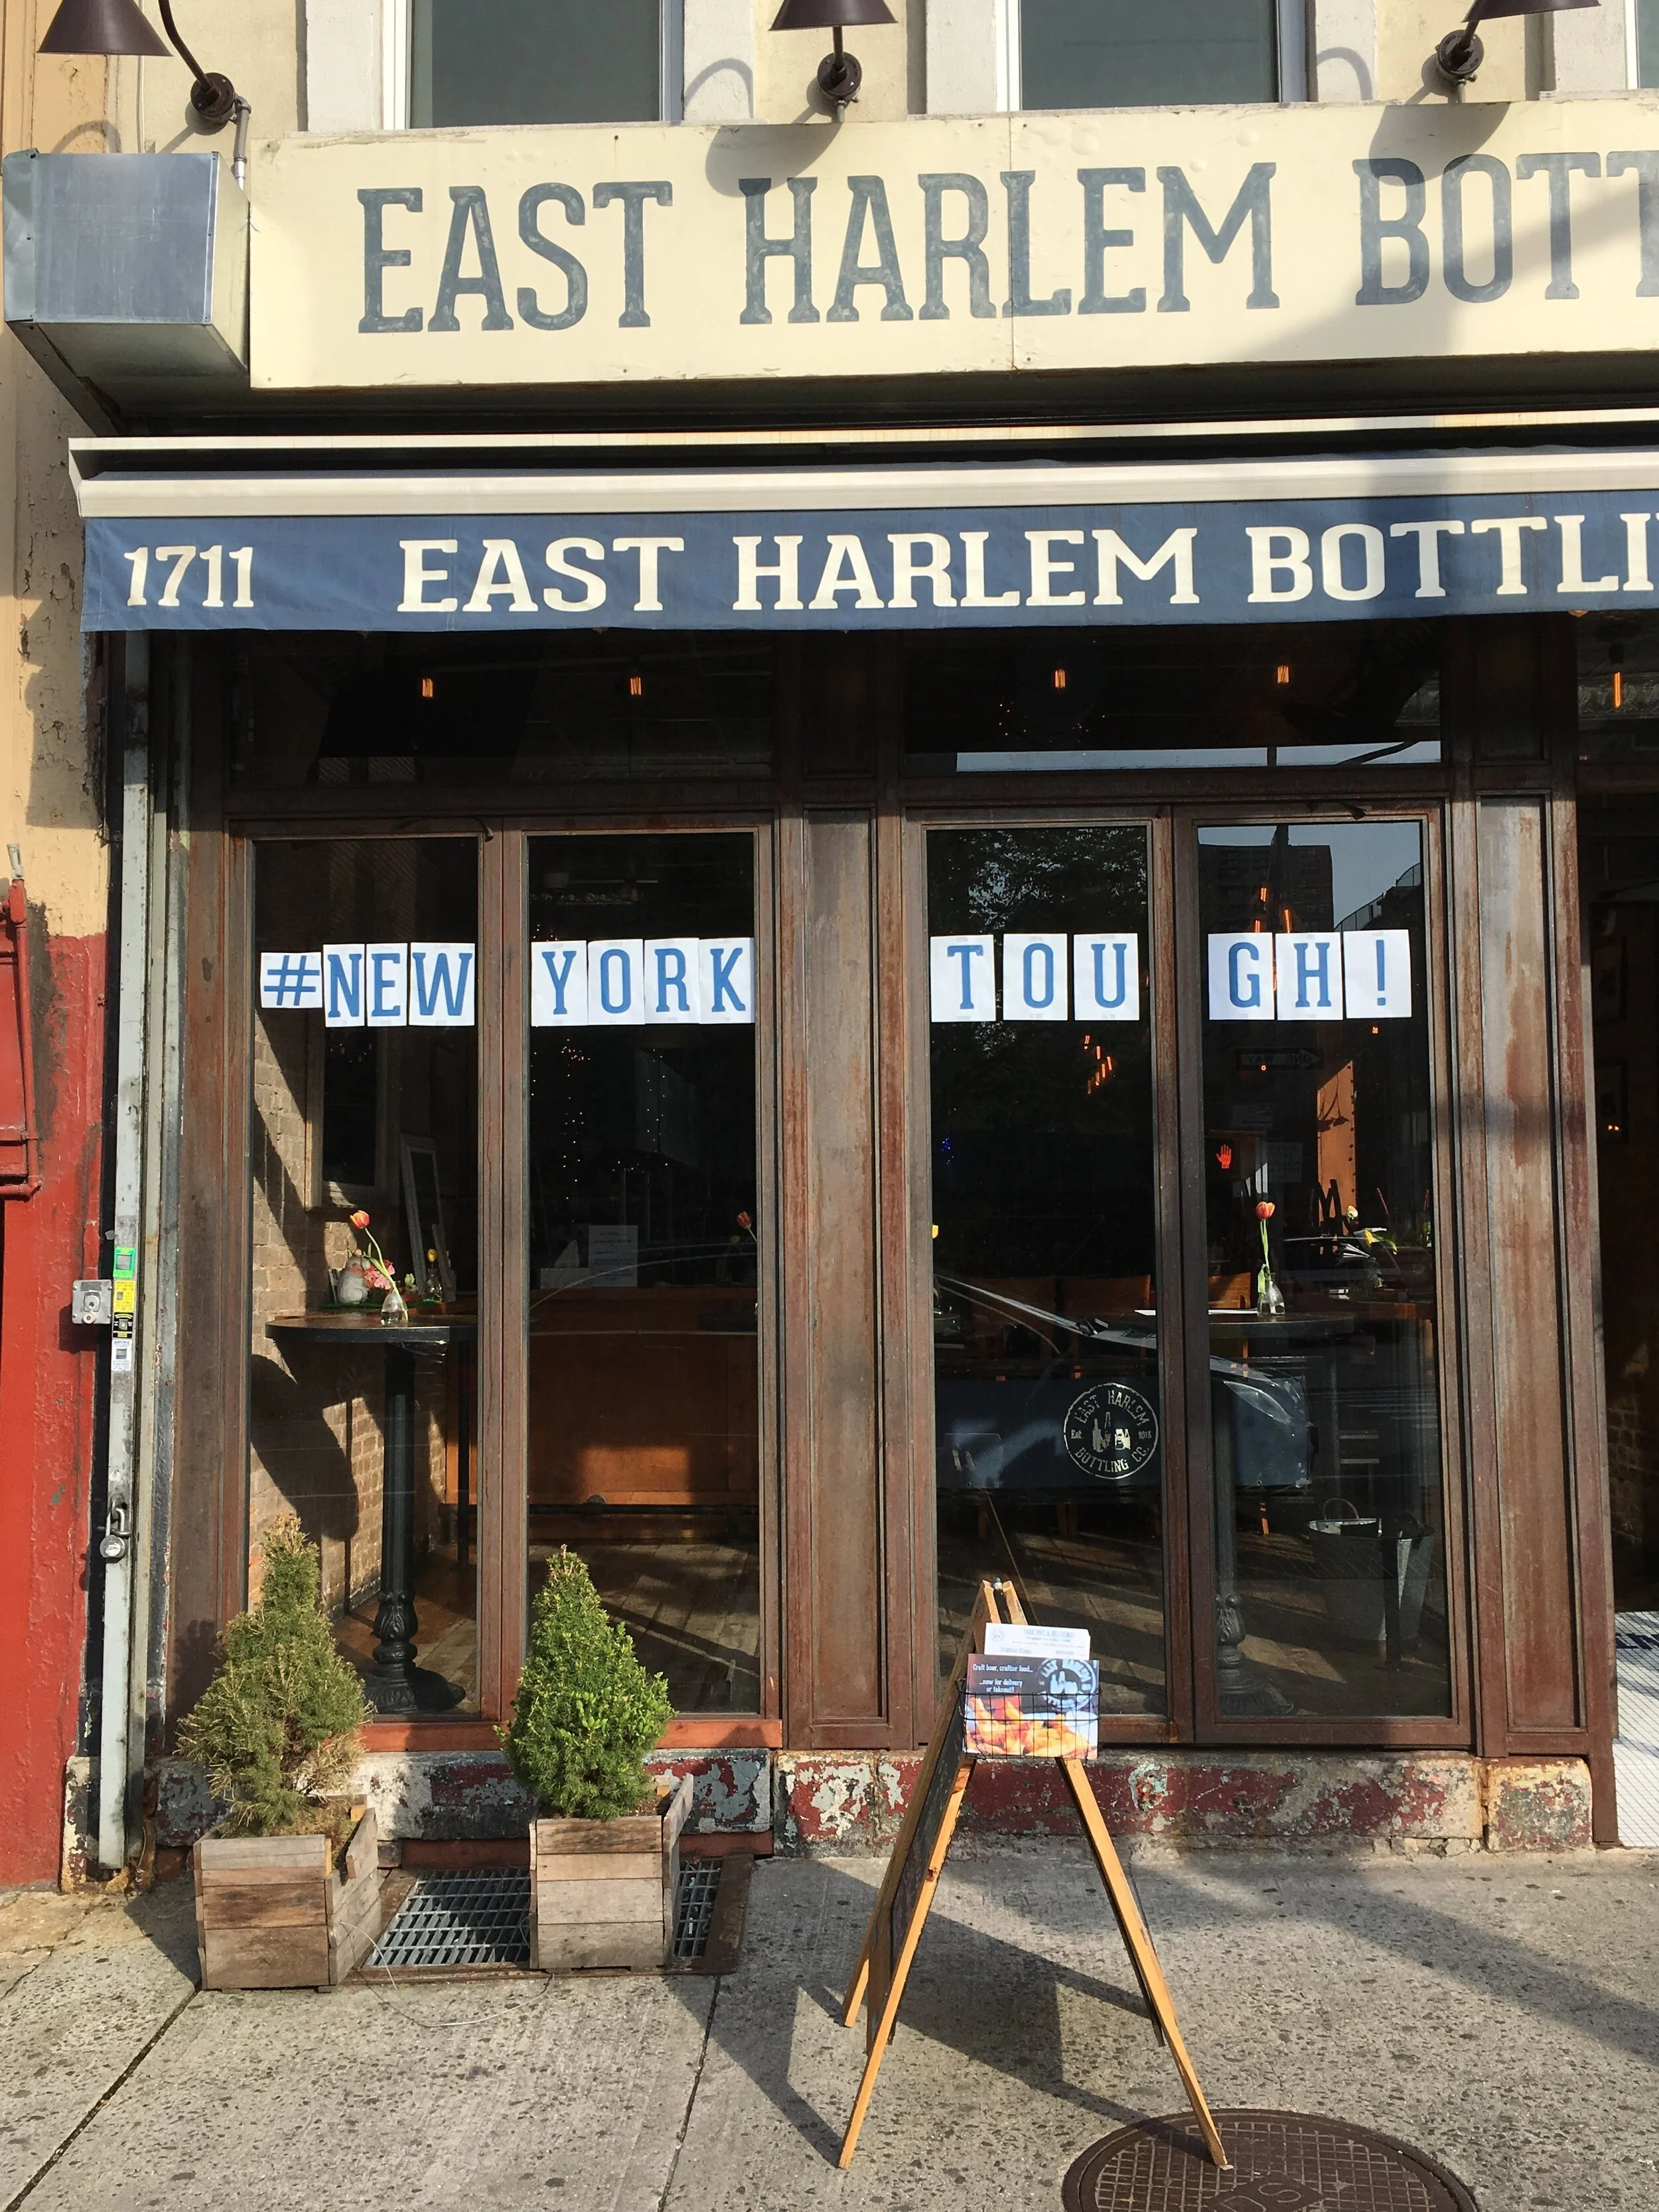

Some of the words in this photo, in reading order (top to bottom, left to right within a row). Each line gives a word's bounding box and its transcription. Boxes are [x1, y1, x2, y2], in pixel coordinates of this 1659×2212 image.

[357, 181, 672, 334] EAST
[738, 163, 1280, 325] HARLEM
[124, 544, 255, 608] 1711
[397, 537, 684, 612] EAST
[733, 528, 1200, 610] HARLEM
[1245, 513, 1659, 603] BOTTLI
[541, 947, 747, 1015] YORK
[1074, 1394, 1100, 1424] EAST
[1108, 1390, 1150, 1426] HARLEM
[1075, 1447, 1129, 1473] BOTTLING
[1003, 1678, 1023, 1688] delivery
